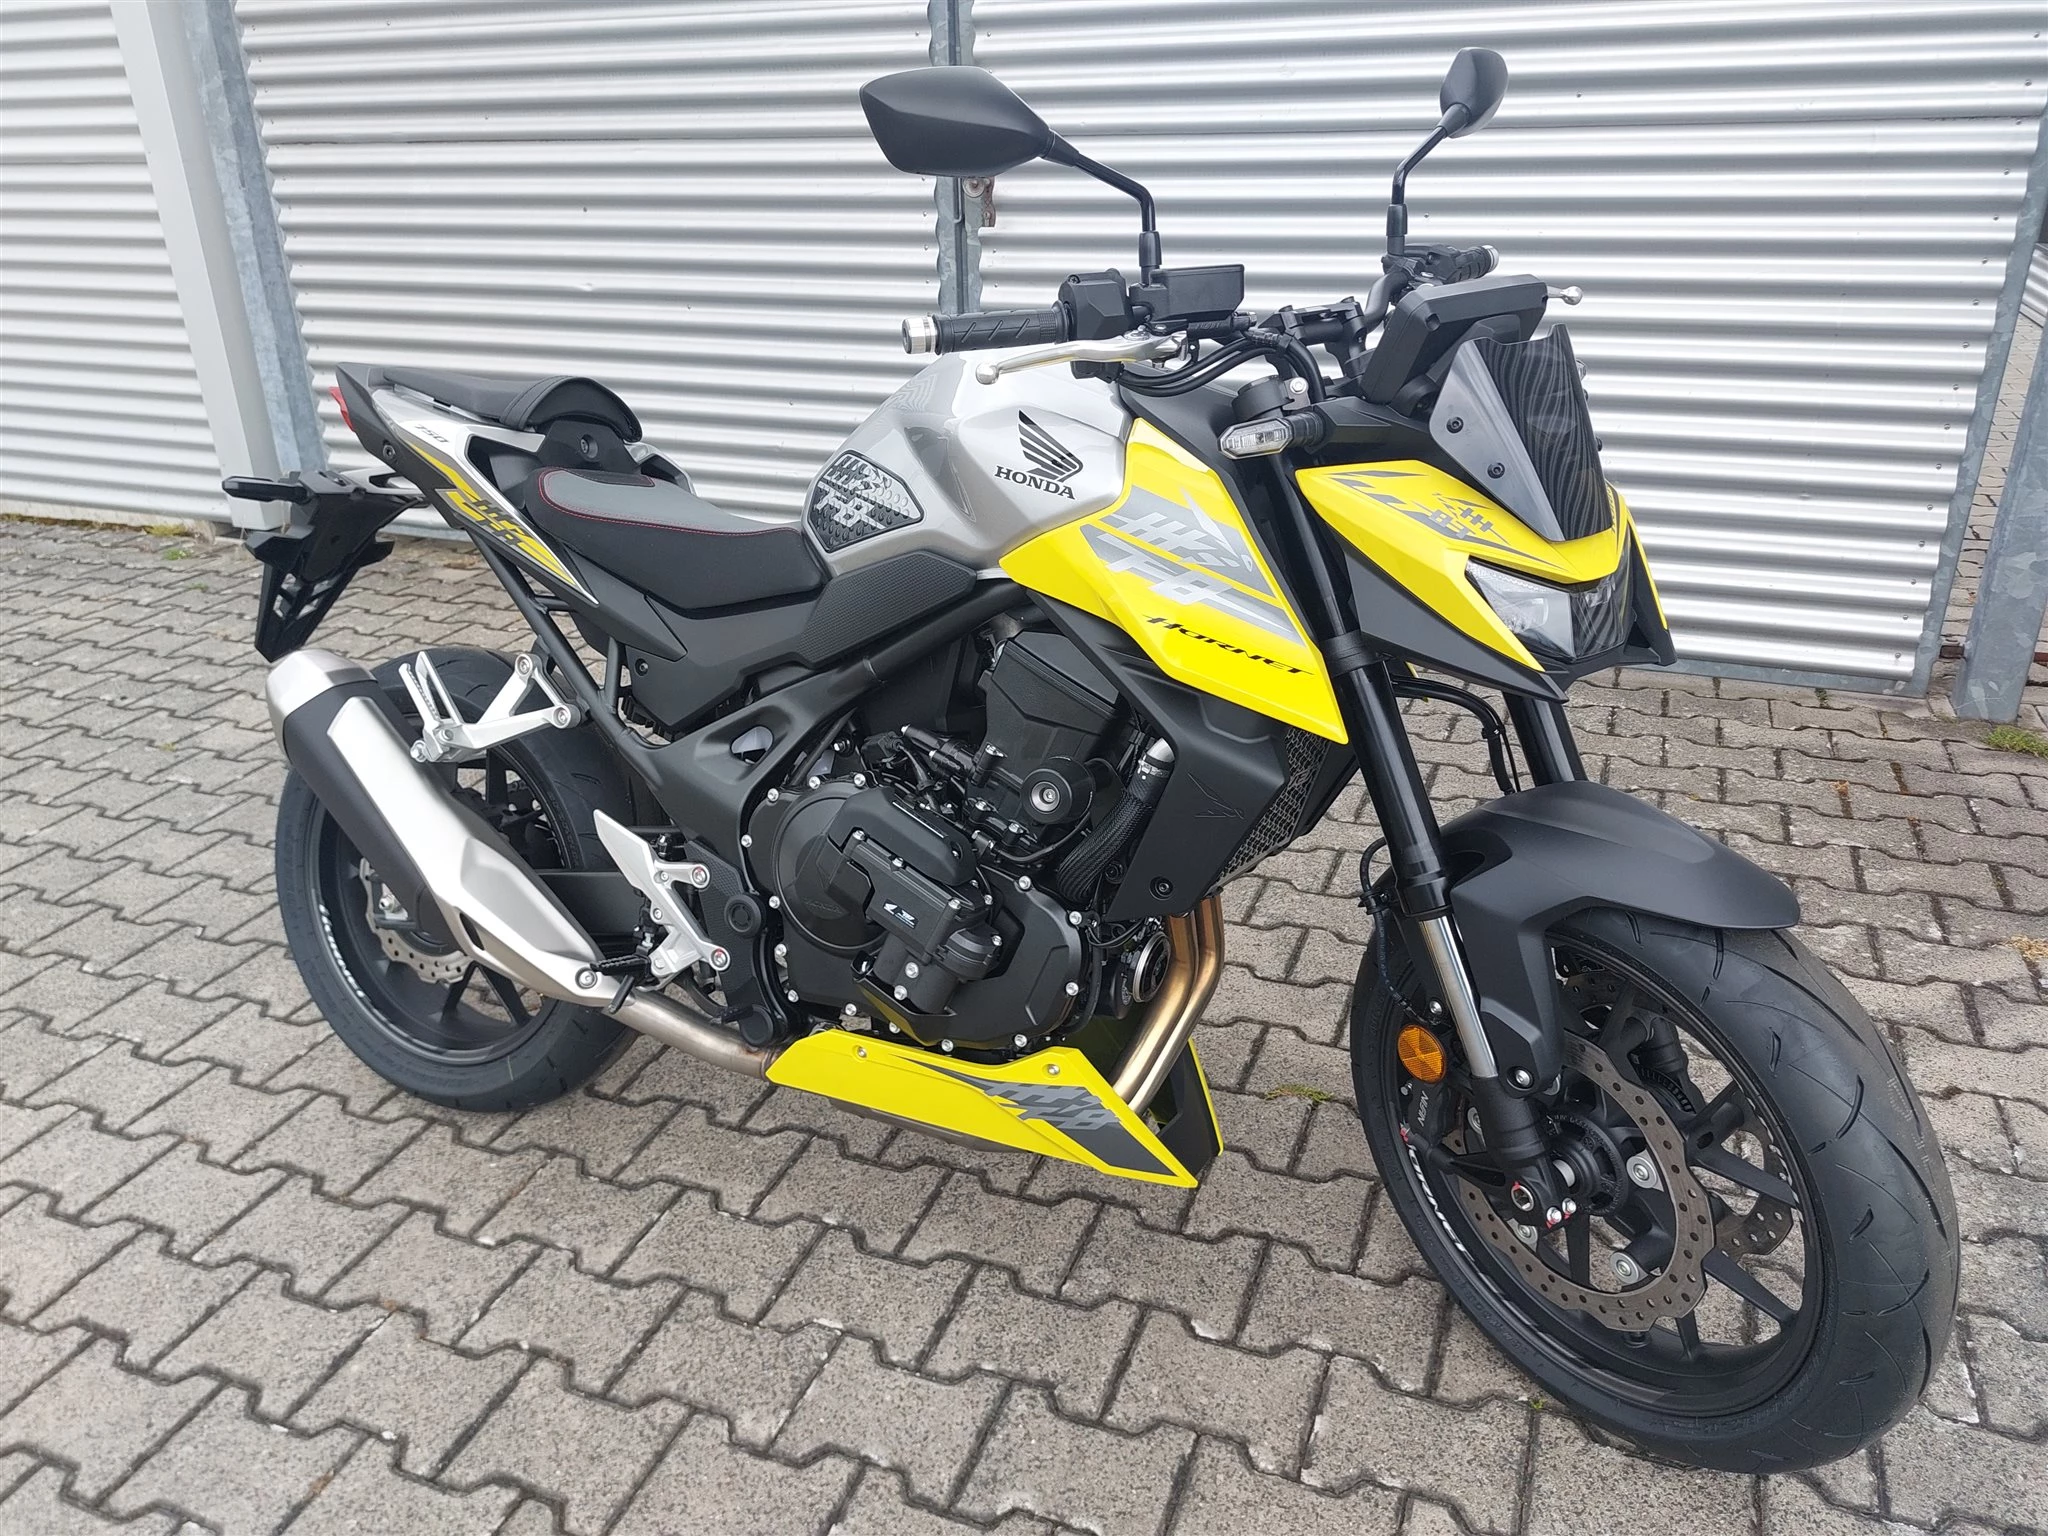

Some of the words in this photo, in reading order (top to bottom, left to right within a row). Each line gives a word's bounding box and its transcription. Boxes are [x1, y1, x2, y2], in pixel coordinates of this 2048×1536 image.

[994, 465, 1076, 500] HONDA
[1143, 614, 1315, 675] HORNET
[1406, 1143, 1474, 1261] ORNET
